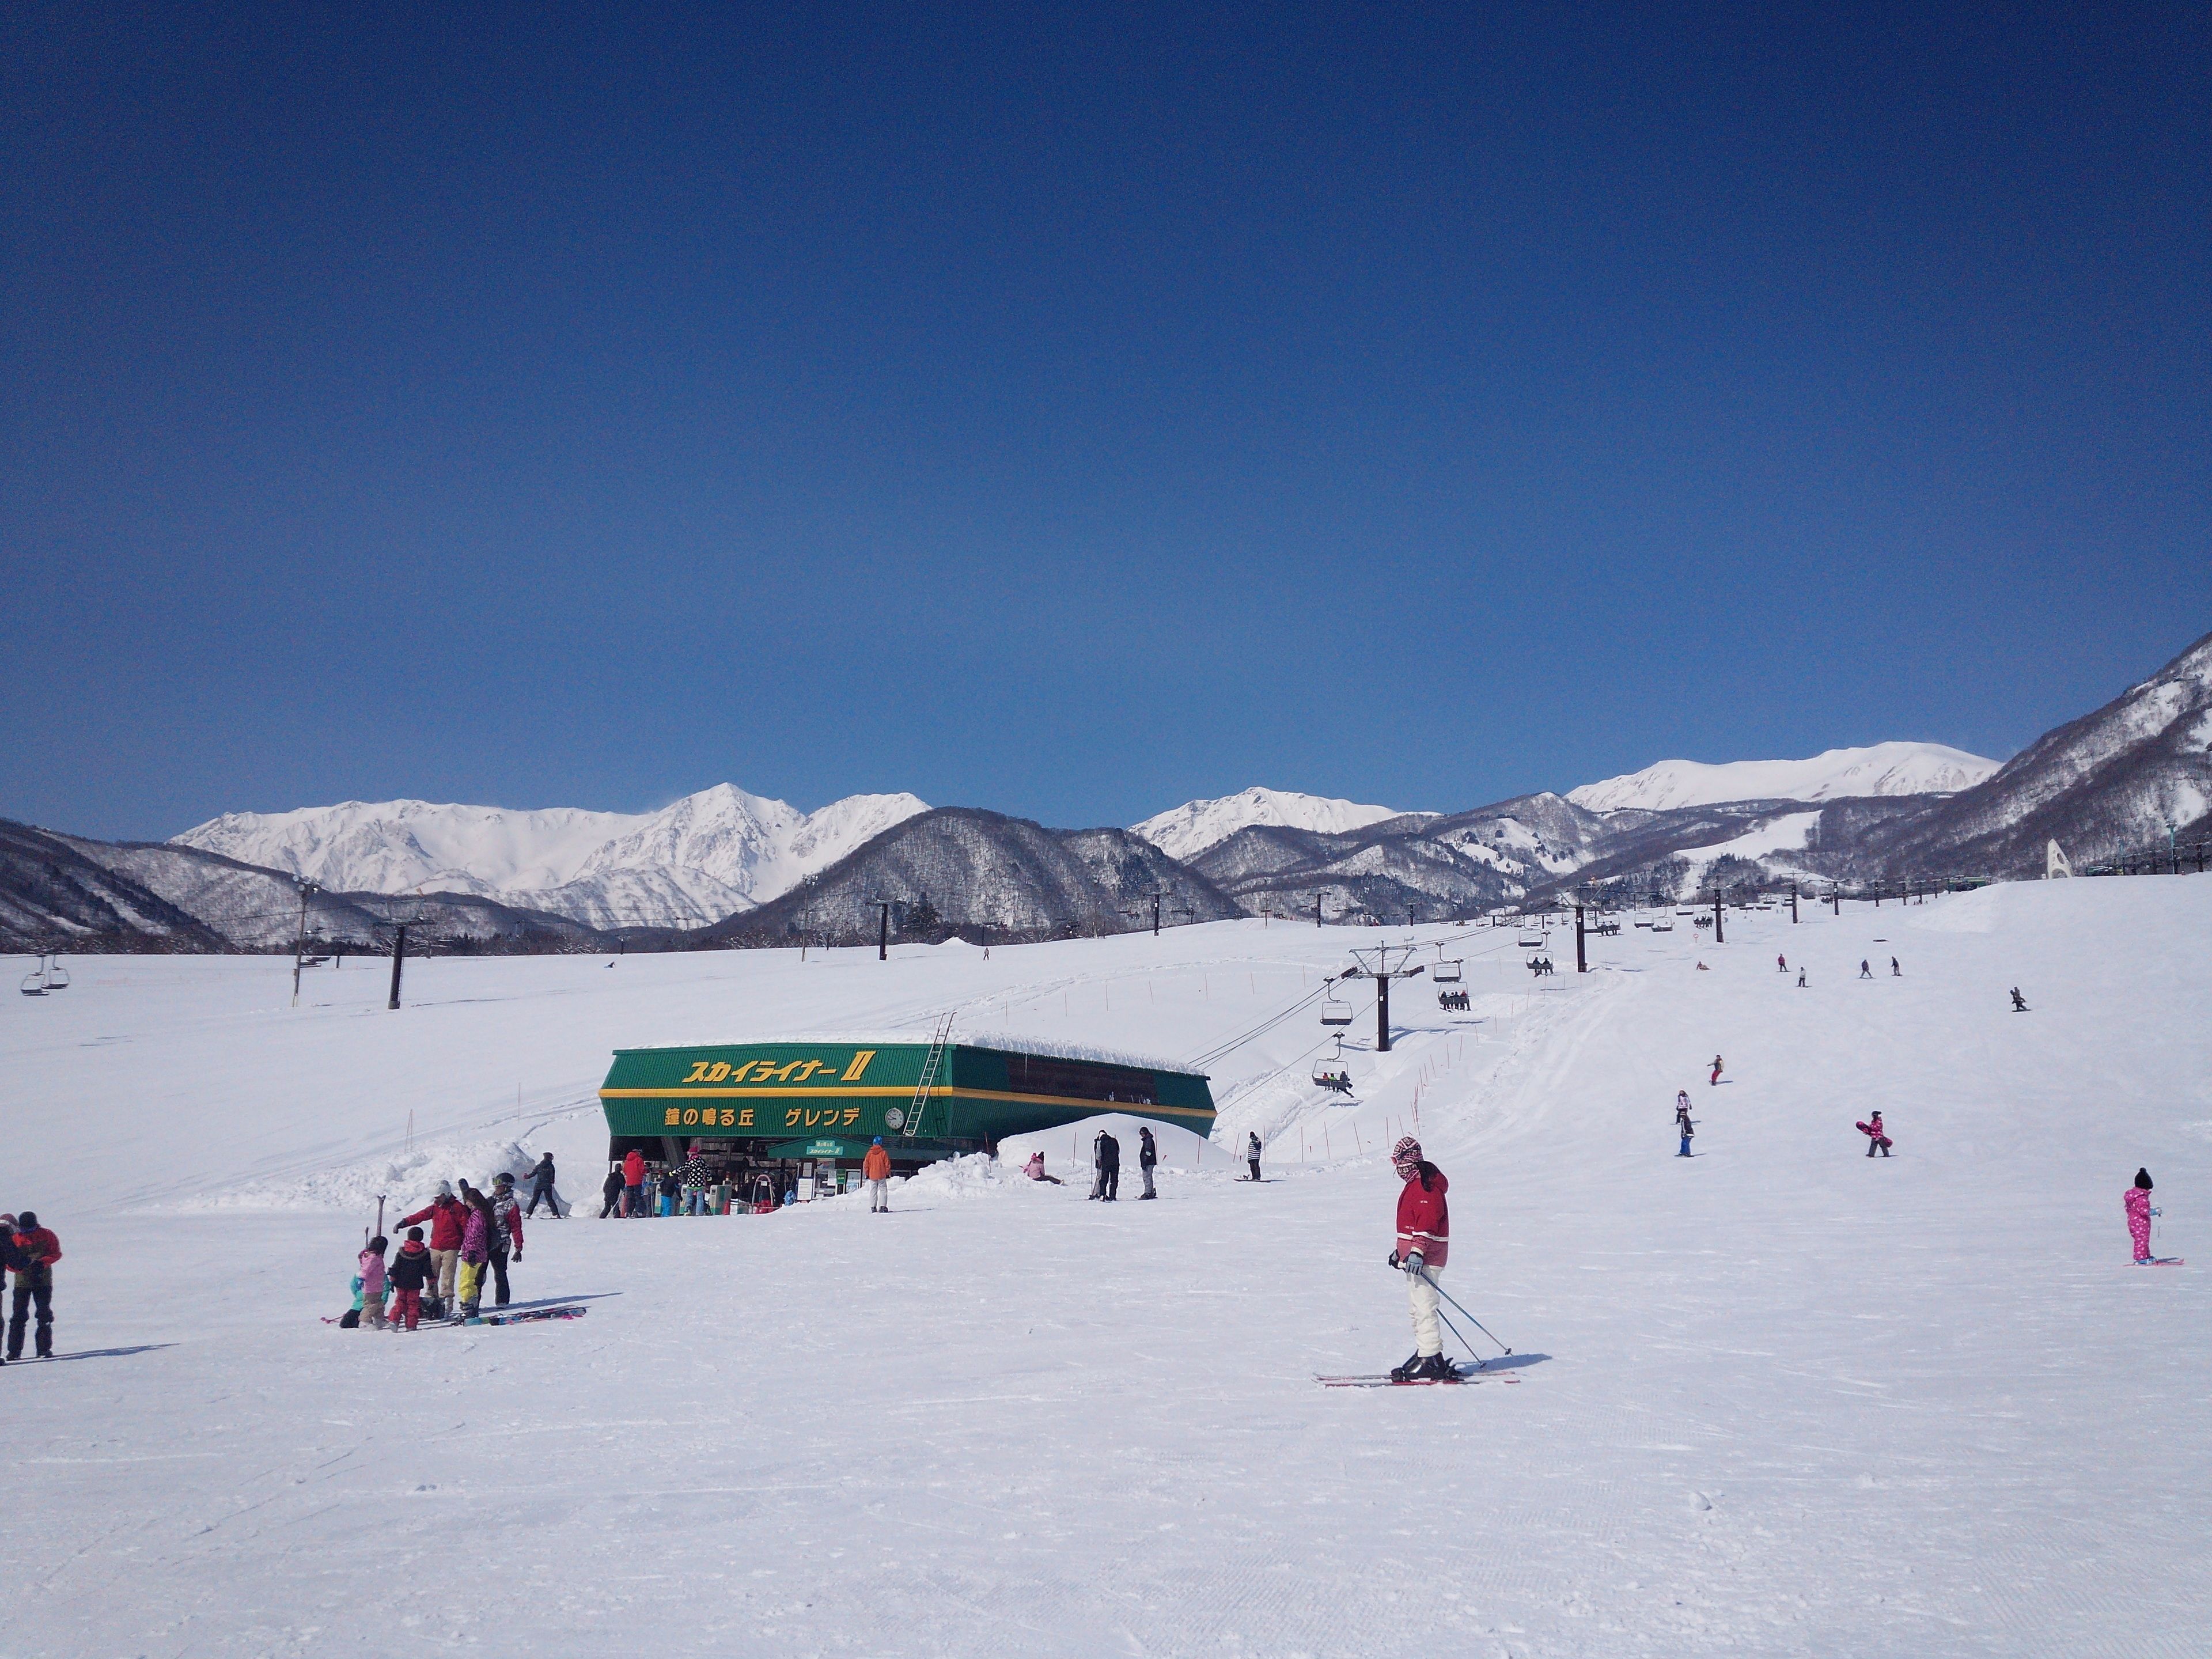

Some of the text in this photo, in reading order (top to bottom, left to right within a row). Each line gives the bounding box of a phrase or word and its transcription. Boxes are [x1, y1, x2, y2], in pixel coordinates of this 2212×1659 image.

[665, 1108, 859, 1126] 鐘の鳴る丘 ゲレンデ
